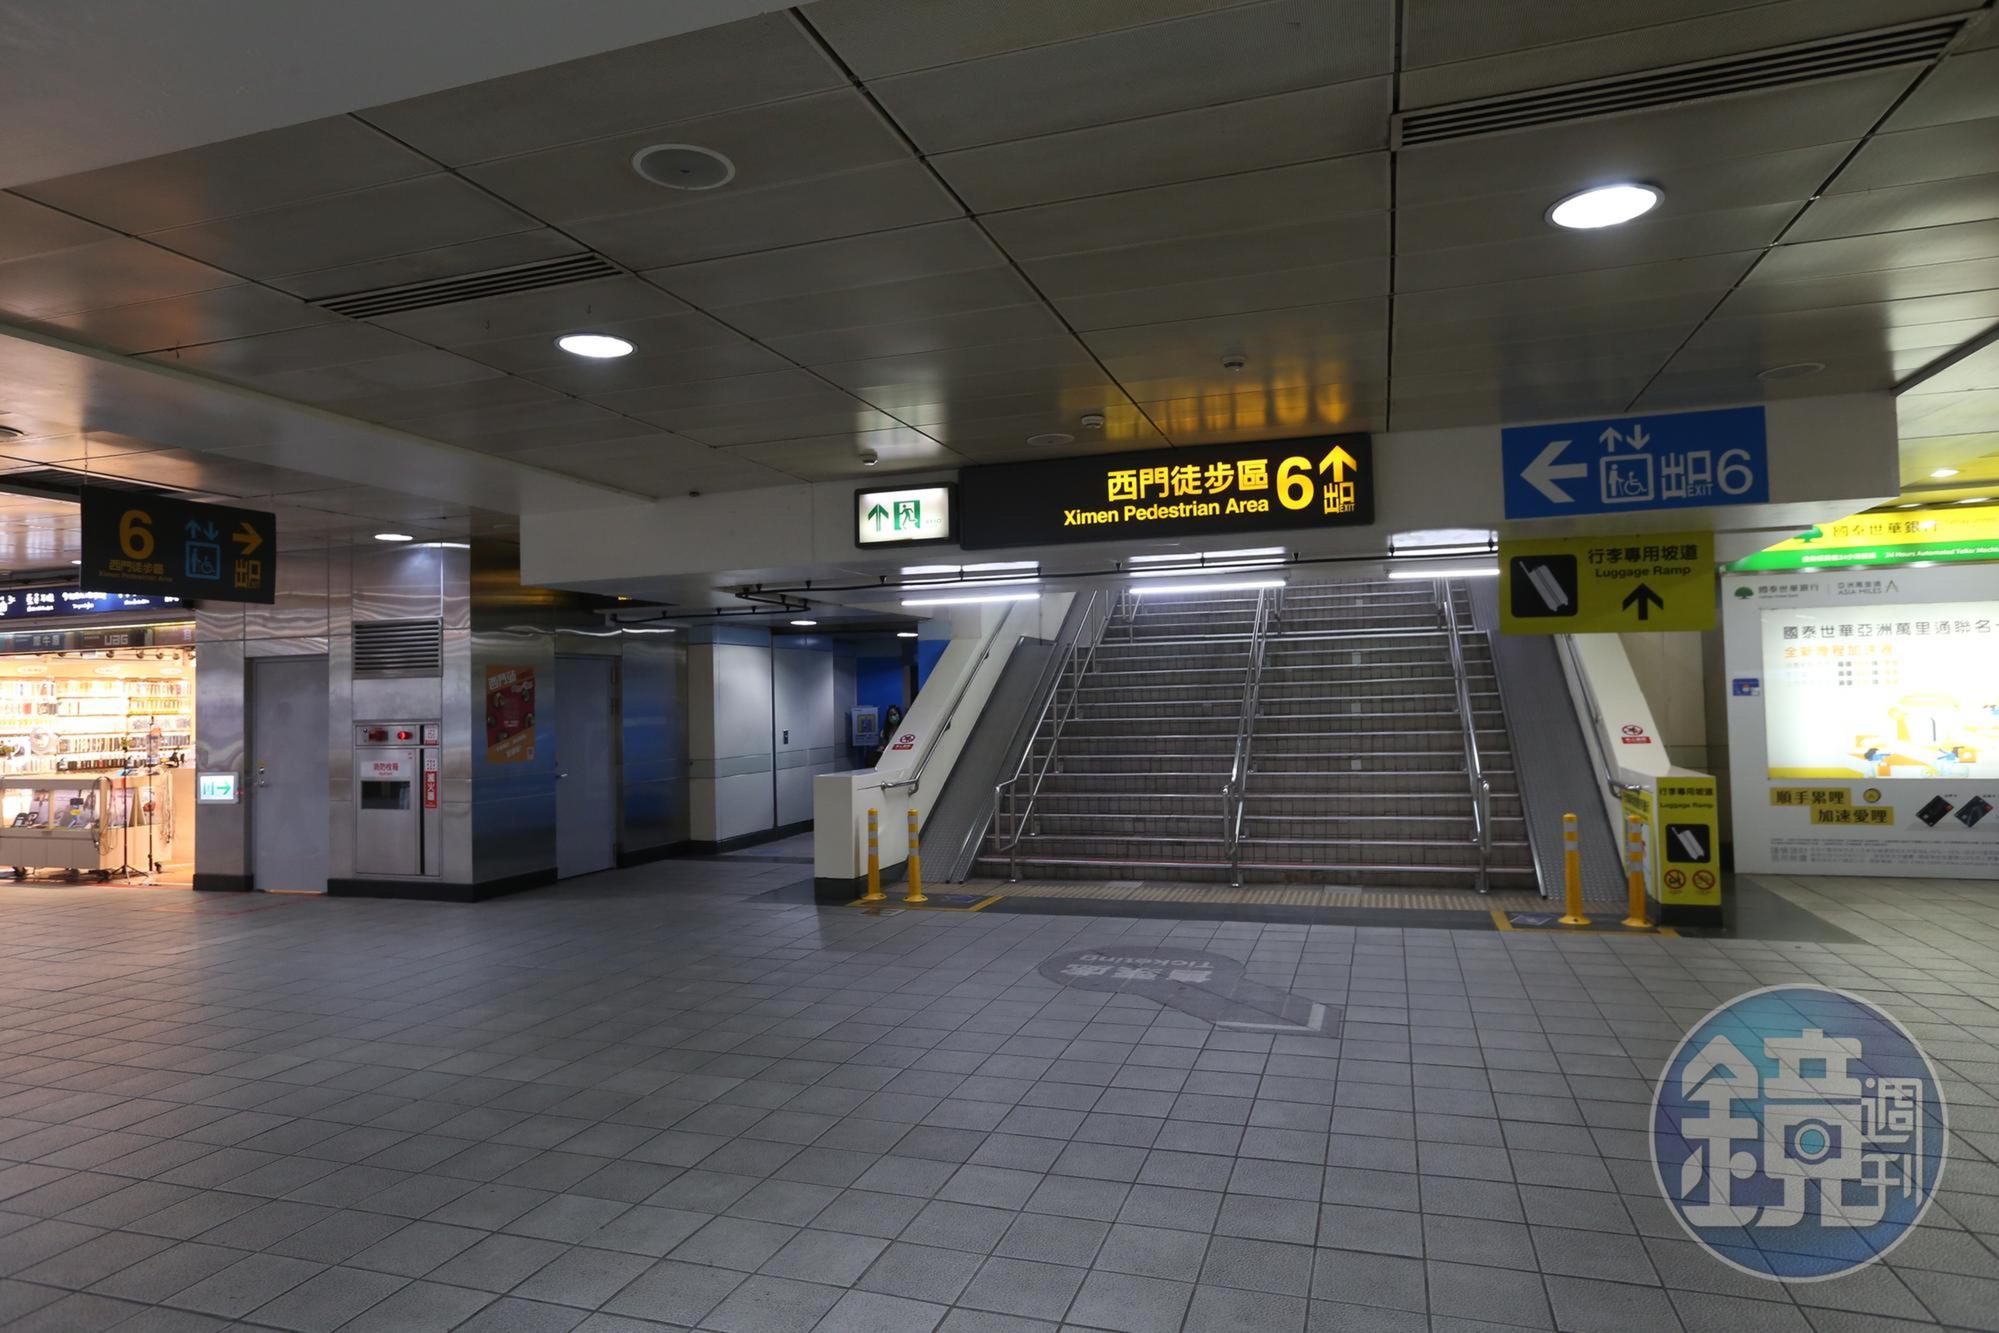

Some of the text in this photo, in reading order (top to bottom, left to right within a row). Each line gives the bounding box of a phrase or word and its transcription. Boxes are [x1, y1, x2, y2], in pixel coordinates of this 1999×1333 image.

[1108, 459, 1268, 502] 西門徒步區
[1661, 451, 1710, 499] 出口
[1718, 449, 1754, 494] 6
[1276, 457, 1314, 509] 6
[1688, 484, 1713, 497] EXIT
[1322, 481, 1356, 515] 出口
[1339, 502, 1356, 513] EXIT
[1064, 498, 1269, 526] Ximen Pedestrian Area
[119, 509, 155, 560] 6
[1589, 545, 1697, 564] 行李專用坡道
[1596, 565, 1691, 578] Luggage Ramp
[1783, 619, 1999, 640] 國泰世華亞洲萬里通聯名
[1660, 787, 1713, 797] 行李專用坡道
[1660, 801, 1713, 810] Luggage Ramp
[1818, 809, 1889, 824] 加速愛哩
[1079, 953, 1215, 969] Ticketing
